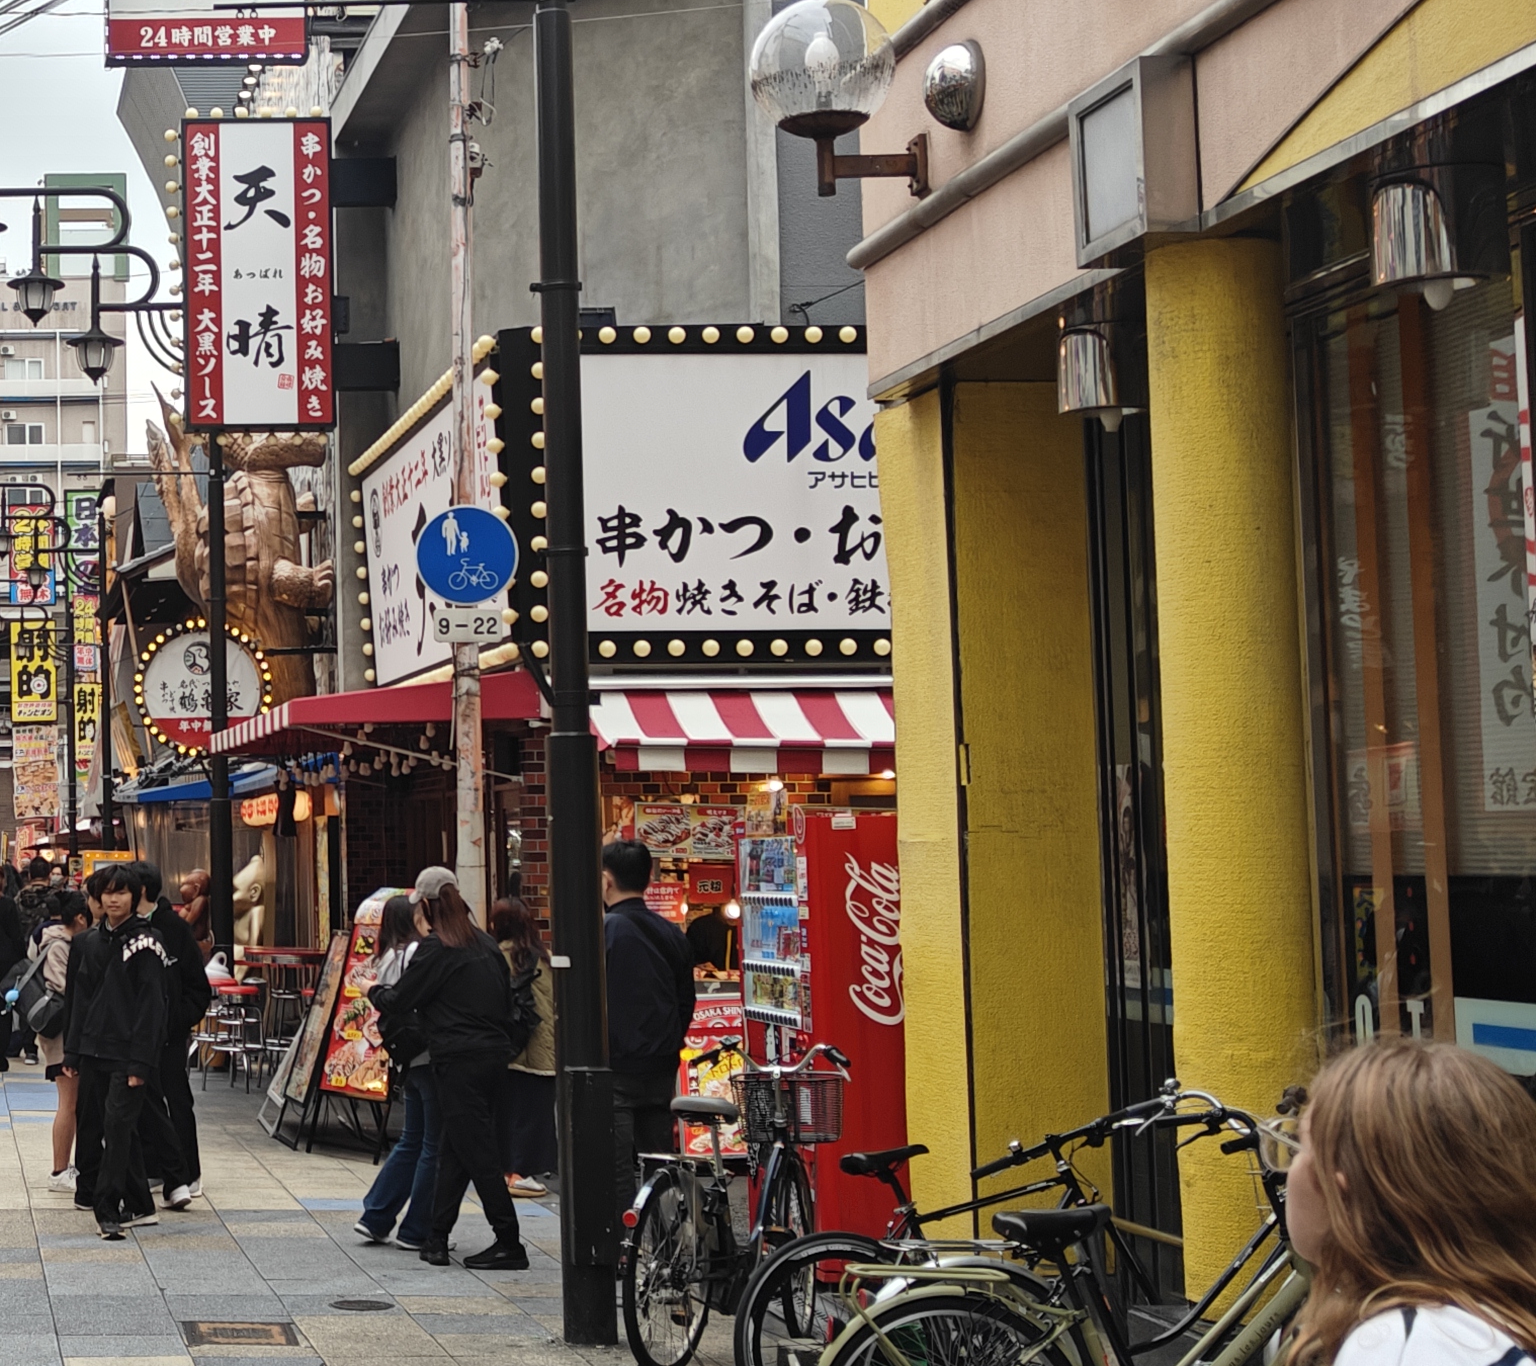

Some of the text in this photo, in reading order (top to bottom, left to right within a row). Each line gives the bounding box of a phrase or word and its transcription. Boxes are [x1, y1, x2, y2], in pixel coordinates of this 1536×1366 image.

[140, 25, 277, 48] 24時間営業中
[190, 132, 219, 419] 創業大正十二年 大黒ソース
[300, 132, 329, 418] 串かつ・名物お好み焼き
[592, 578, 892, 620] 名物焼きそば・鉄
[17, 627, 52, 700] 射的
[75, 686, 97, 743] 射的
[696, 879, 724, 894] 元祖
[846, 851, 904, 1027] Coca-Cola
[693, 1005, 743, 1022] OSAKA SHIN
